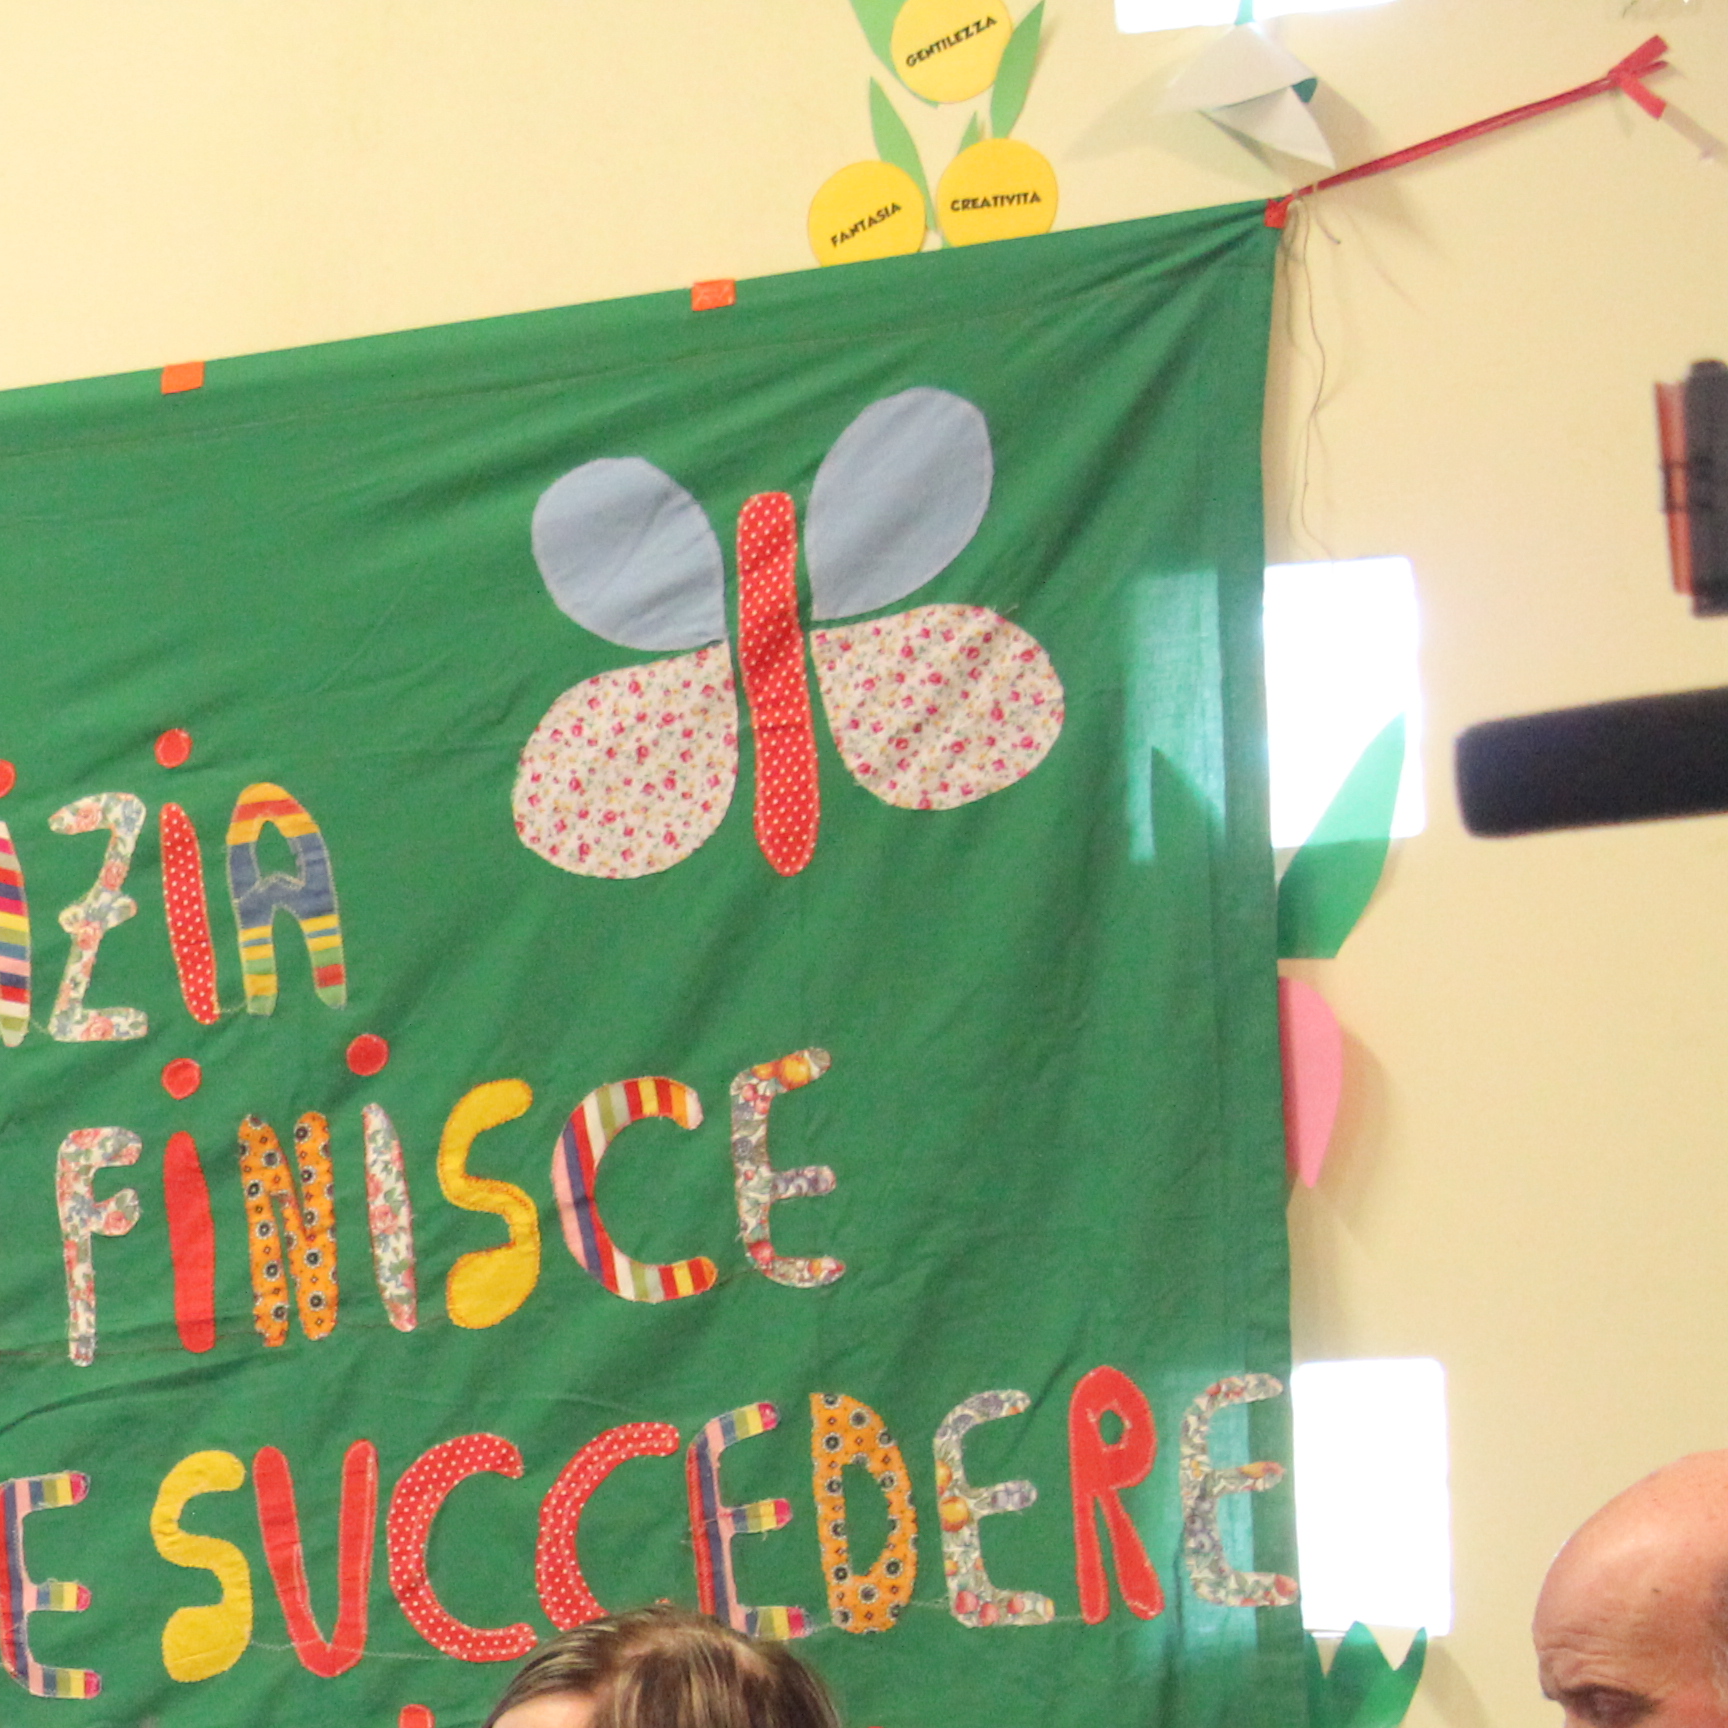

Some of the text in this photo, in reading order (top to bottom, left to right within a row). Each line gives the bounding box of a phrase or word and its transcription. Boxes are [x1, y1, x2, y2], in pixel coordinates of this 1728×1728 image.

[905, 16, 997, 67] GENTILEZZA
[830, 202, 902, 248] FANTASIA
[150, 1364, 1299, 1684] SUCCEDERE
